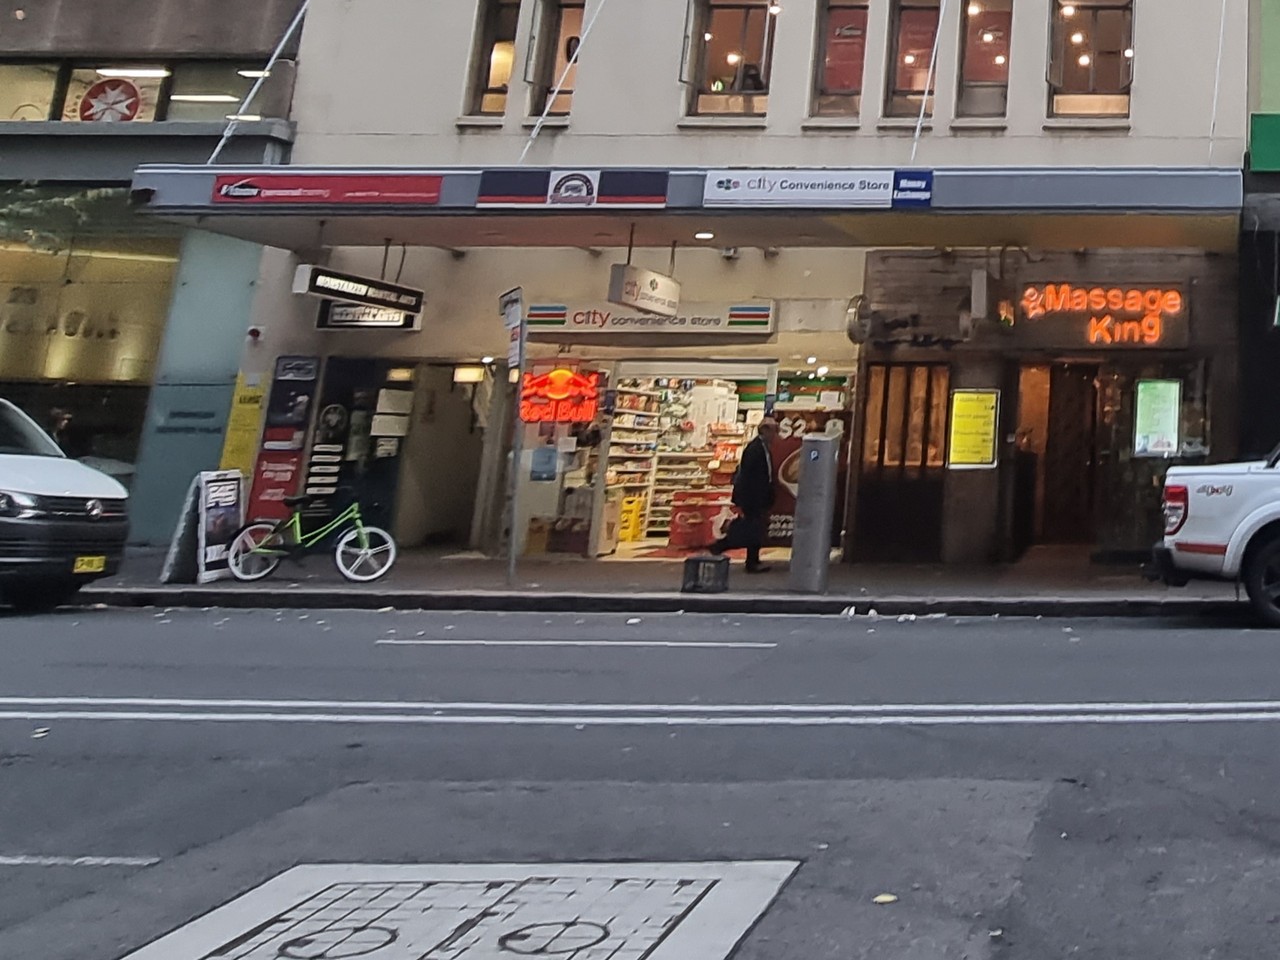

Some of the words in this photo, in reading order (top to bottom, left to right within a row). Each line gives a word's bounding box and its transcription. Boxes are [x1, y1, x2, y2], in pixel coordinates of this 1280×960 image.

[779, 180, 855, 191] Convenience
[858, 179, 889, 190] Store
[1045, 283, 1182, 315] Massage
[573, 309, 611, 328] city
[611, 316, 687, 326] convenience
[690, 315, 721, 326] store
[1088, 315, 1161, 344] King
[520, 401, 555, 422] Red
[557, 401, 596, 422] Bull
